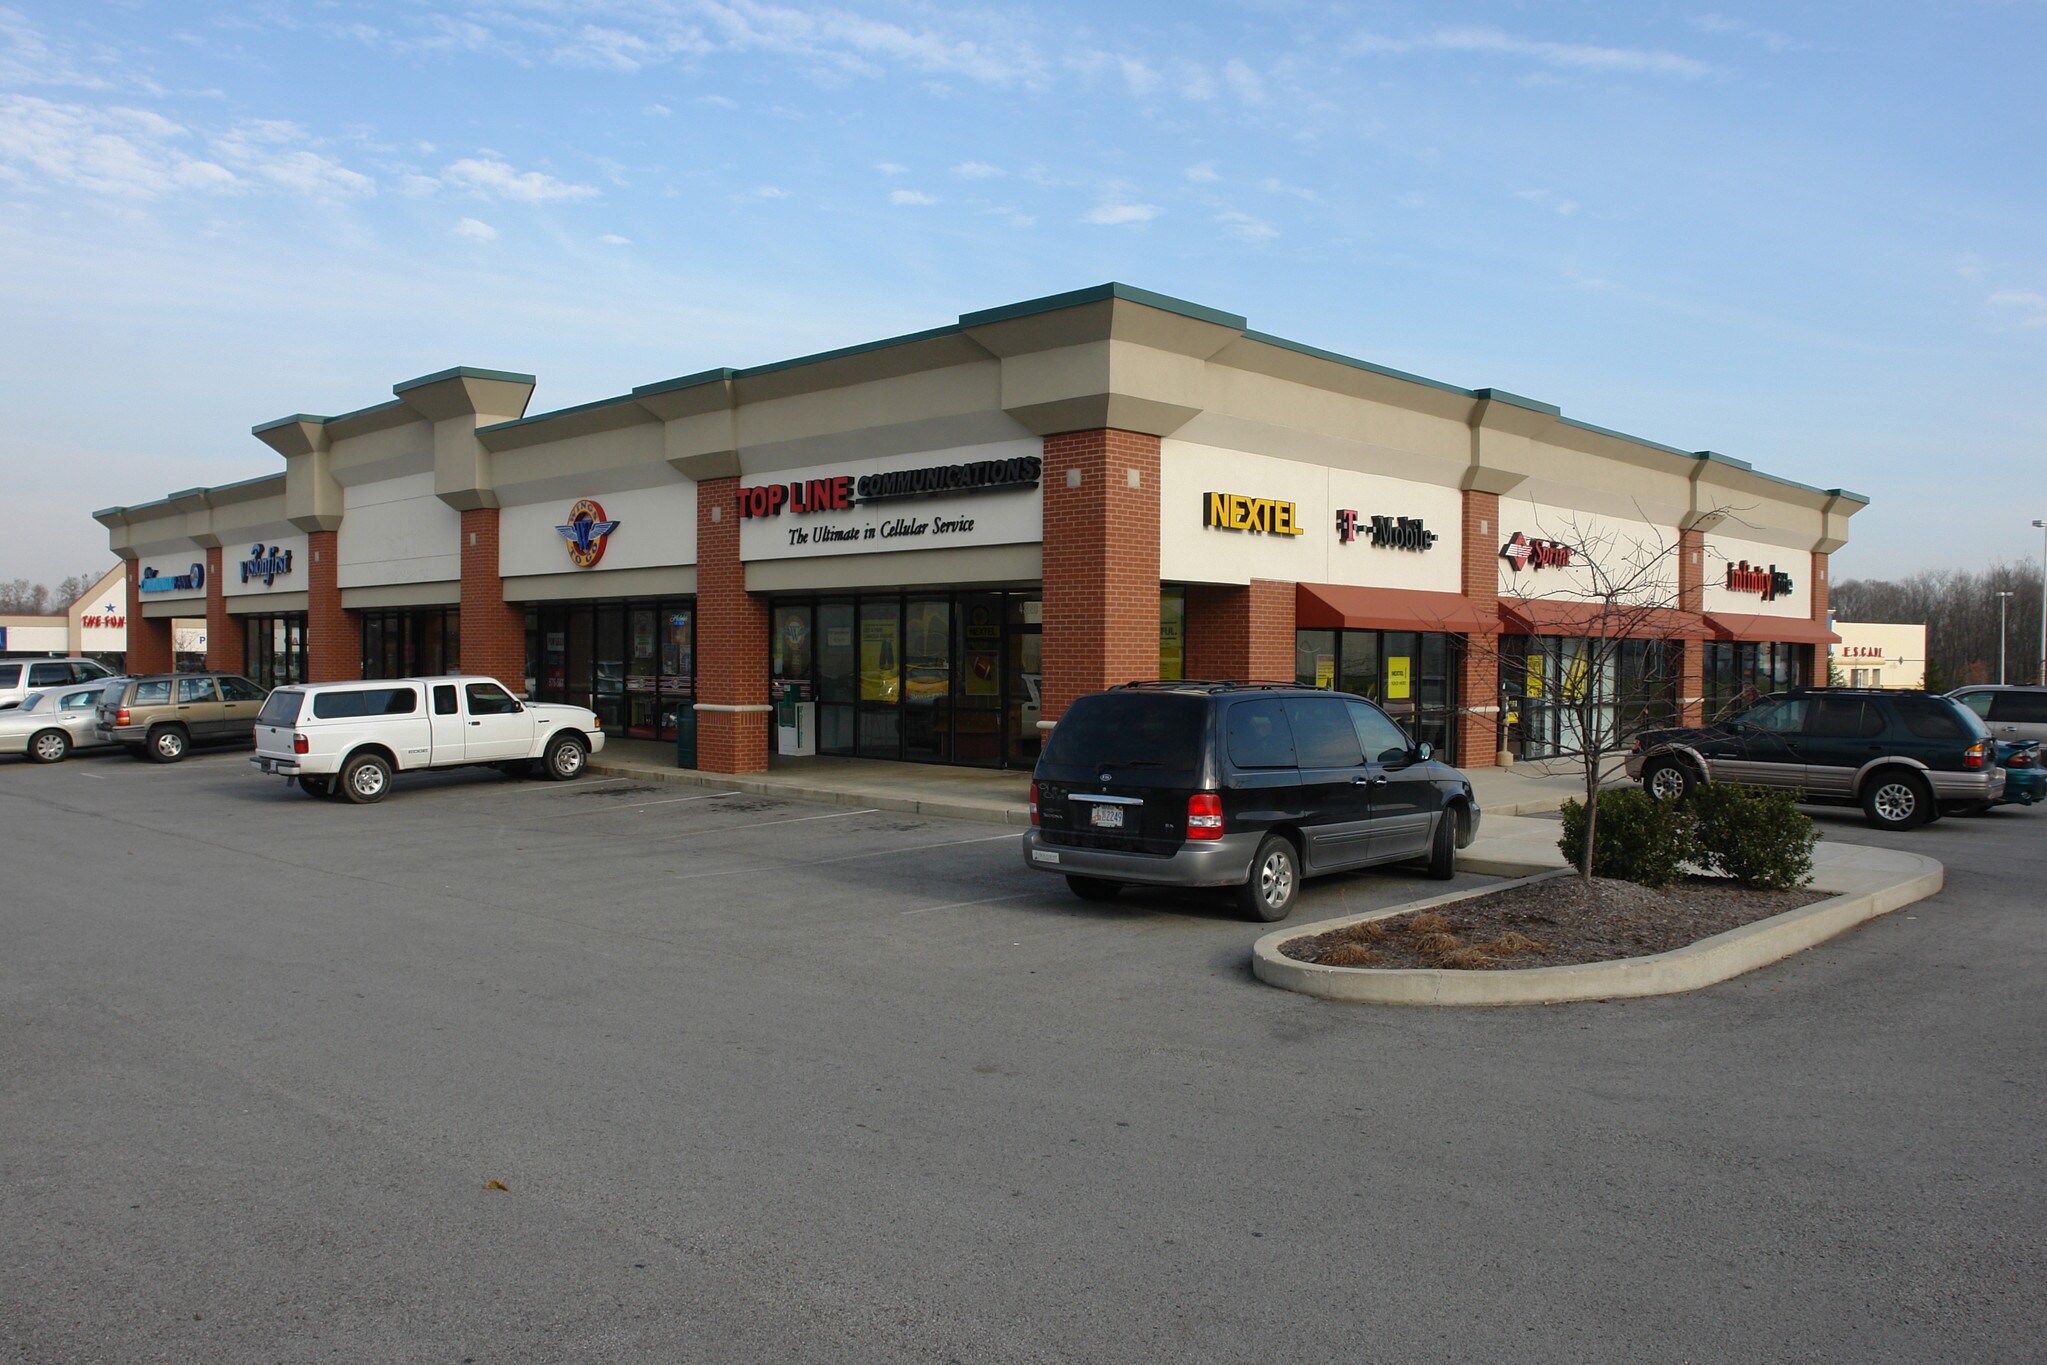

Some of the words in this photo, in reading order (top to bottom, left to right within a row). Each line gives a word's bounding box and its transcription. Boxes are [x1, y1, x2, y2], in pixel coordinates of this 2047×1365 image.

[736, 484, 788, 518] TOP
[790, 476, 855, 513] LINE
[857, 456, 1042, 497] COMMUNICATIONS
[570, 501, 597, 521] WINGS
[1203, 492, 1303, 536] NEXTEL
[788, 527, 808, 546] The
[812, 523, 860, 544] Ultimate
[864, 522, 876, 540] in
[880, 517, 928, 539] Cellular
[932, 514, 975, 535] Service
[82, 615, 102, 628] THE
